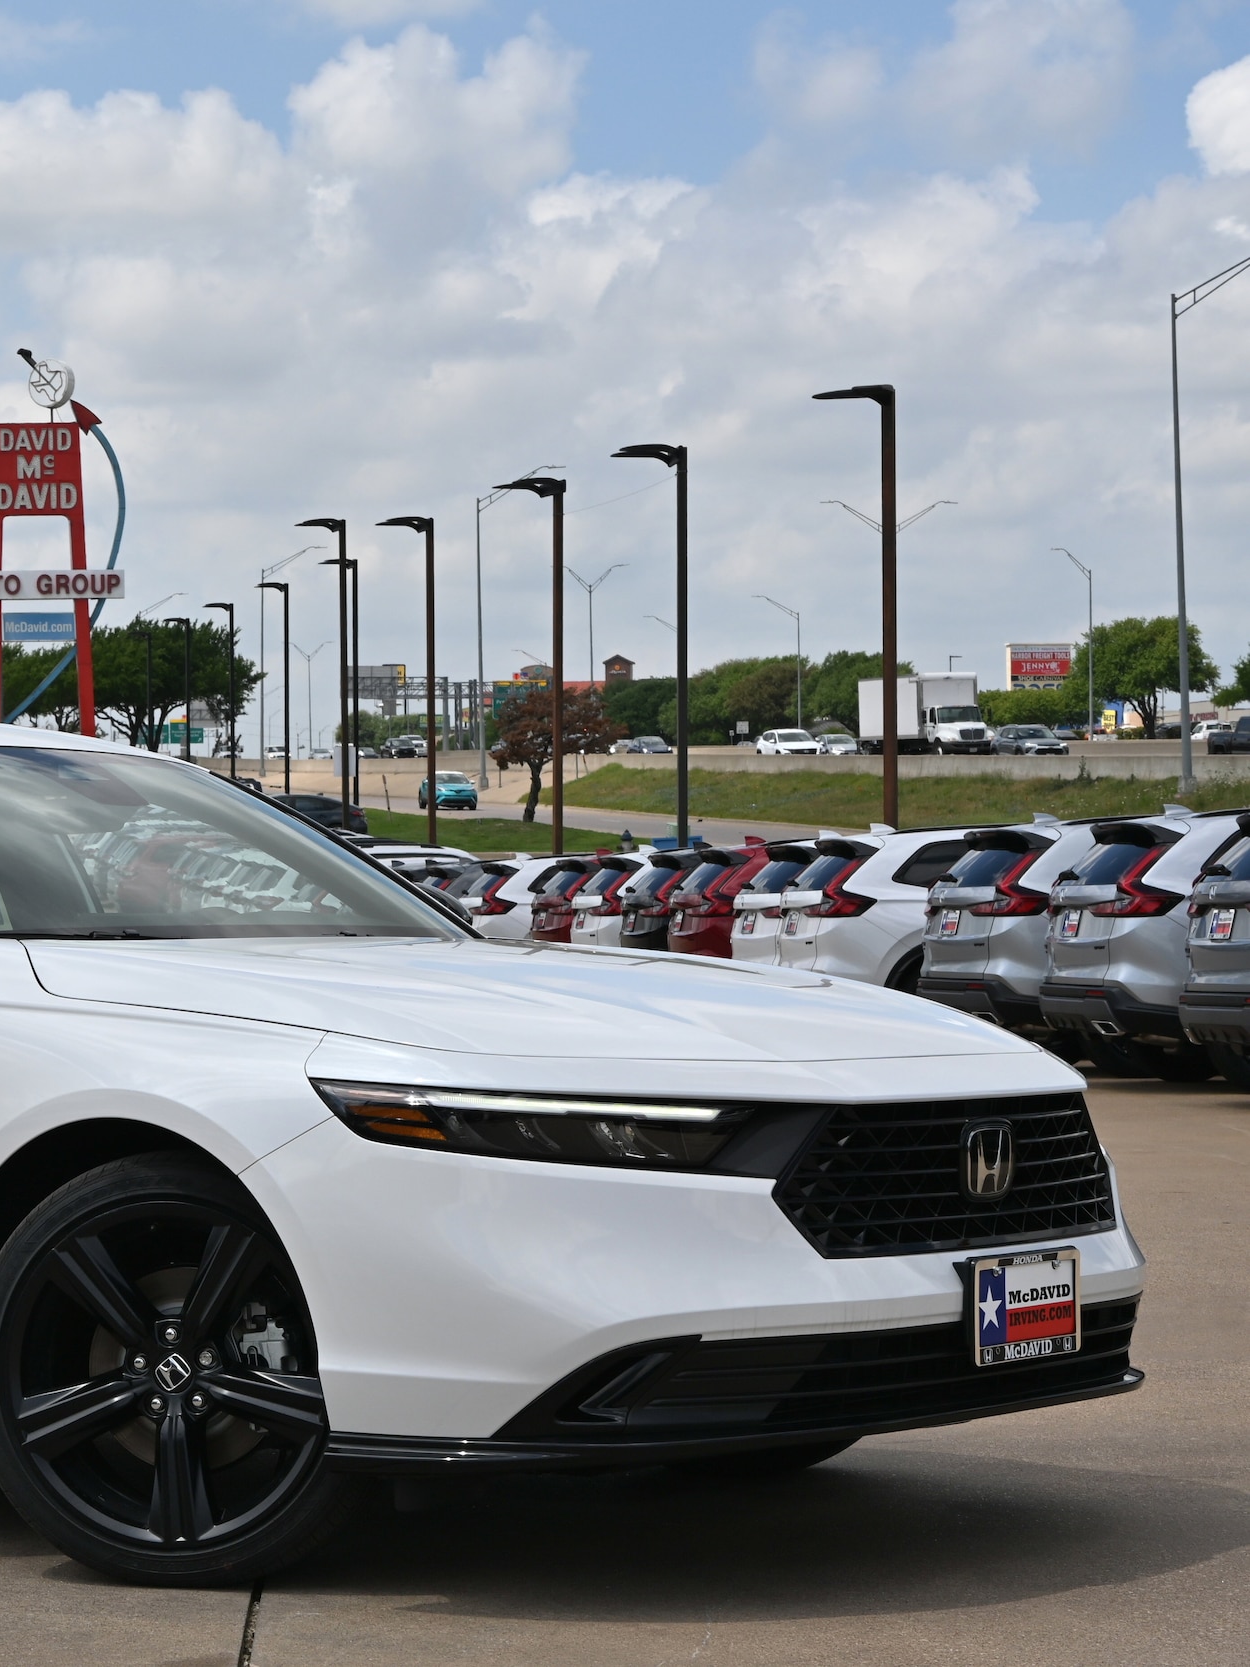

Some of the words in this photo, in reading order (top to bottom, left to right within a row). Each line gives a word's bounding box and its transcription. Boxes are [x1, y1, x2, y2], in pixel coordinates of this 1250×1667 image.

[0, 427, 72, 451] DAVID
[36, 573, 121, 595] GROUP
[5, 621, 72, 633] McDavid.com
[1012, 1254, 1044, 1265] HONDA
[1008, 1284, 1071, 1305] McDAVID
[1009, 1305, 1072, 1327] IRVING.COM
[1004, 1339, 1053, 1361] McDAVID
